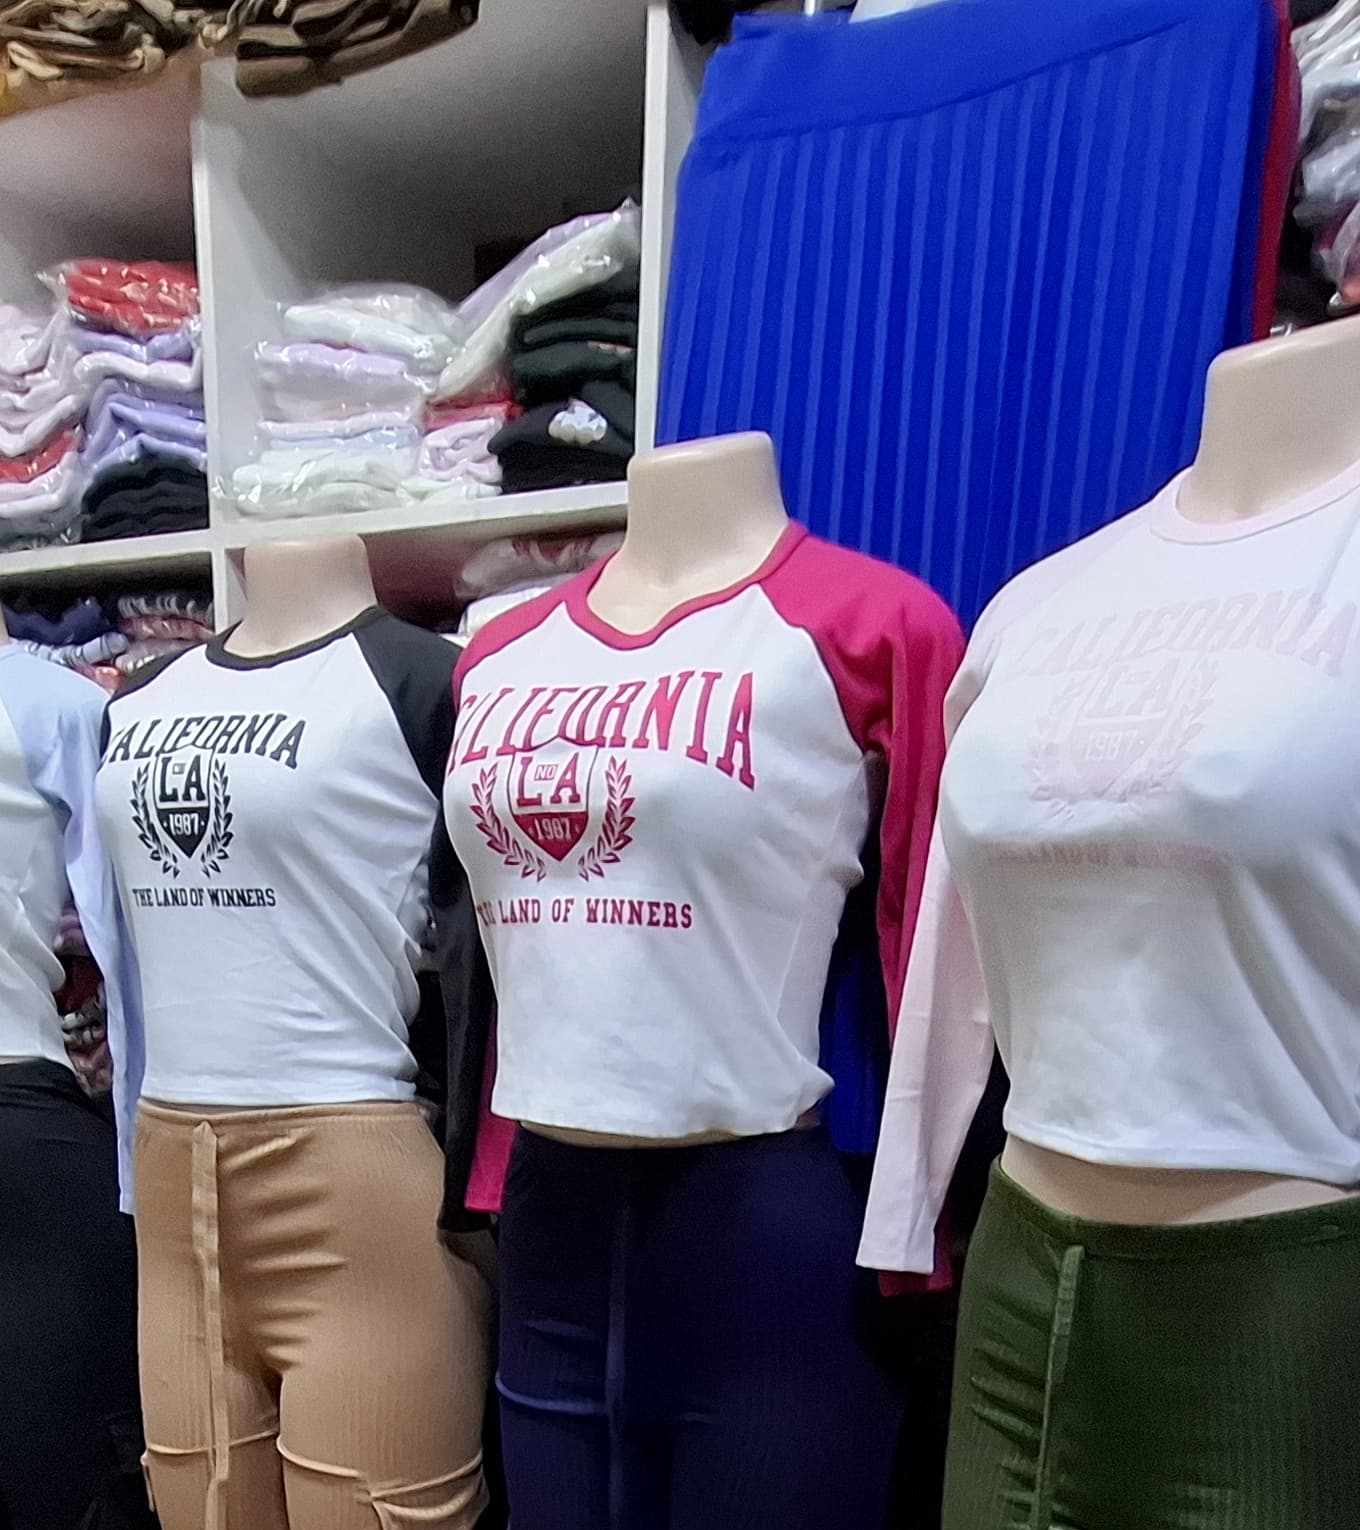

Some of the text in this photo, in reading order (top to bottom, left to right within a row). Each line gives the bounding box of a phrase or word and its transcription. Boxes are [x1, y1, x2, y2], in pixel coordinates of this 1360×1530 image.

[448, 670, 755, 791] LIFORNIA
[1084, 728, 1138, 762] 1987
[168, 812, 199, 836] 1987
[533, 817, 572, 841] 1987
[132, 887, 277, 908] THE LAND OF WINNERS
[499, 898, 540, 924] LAND
[552, 898, 574, 923] OF
[586, 898, 692, 929] WINNERS
